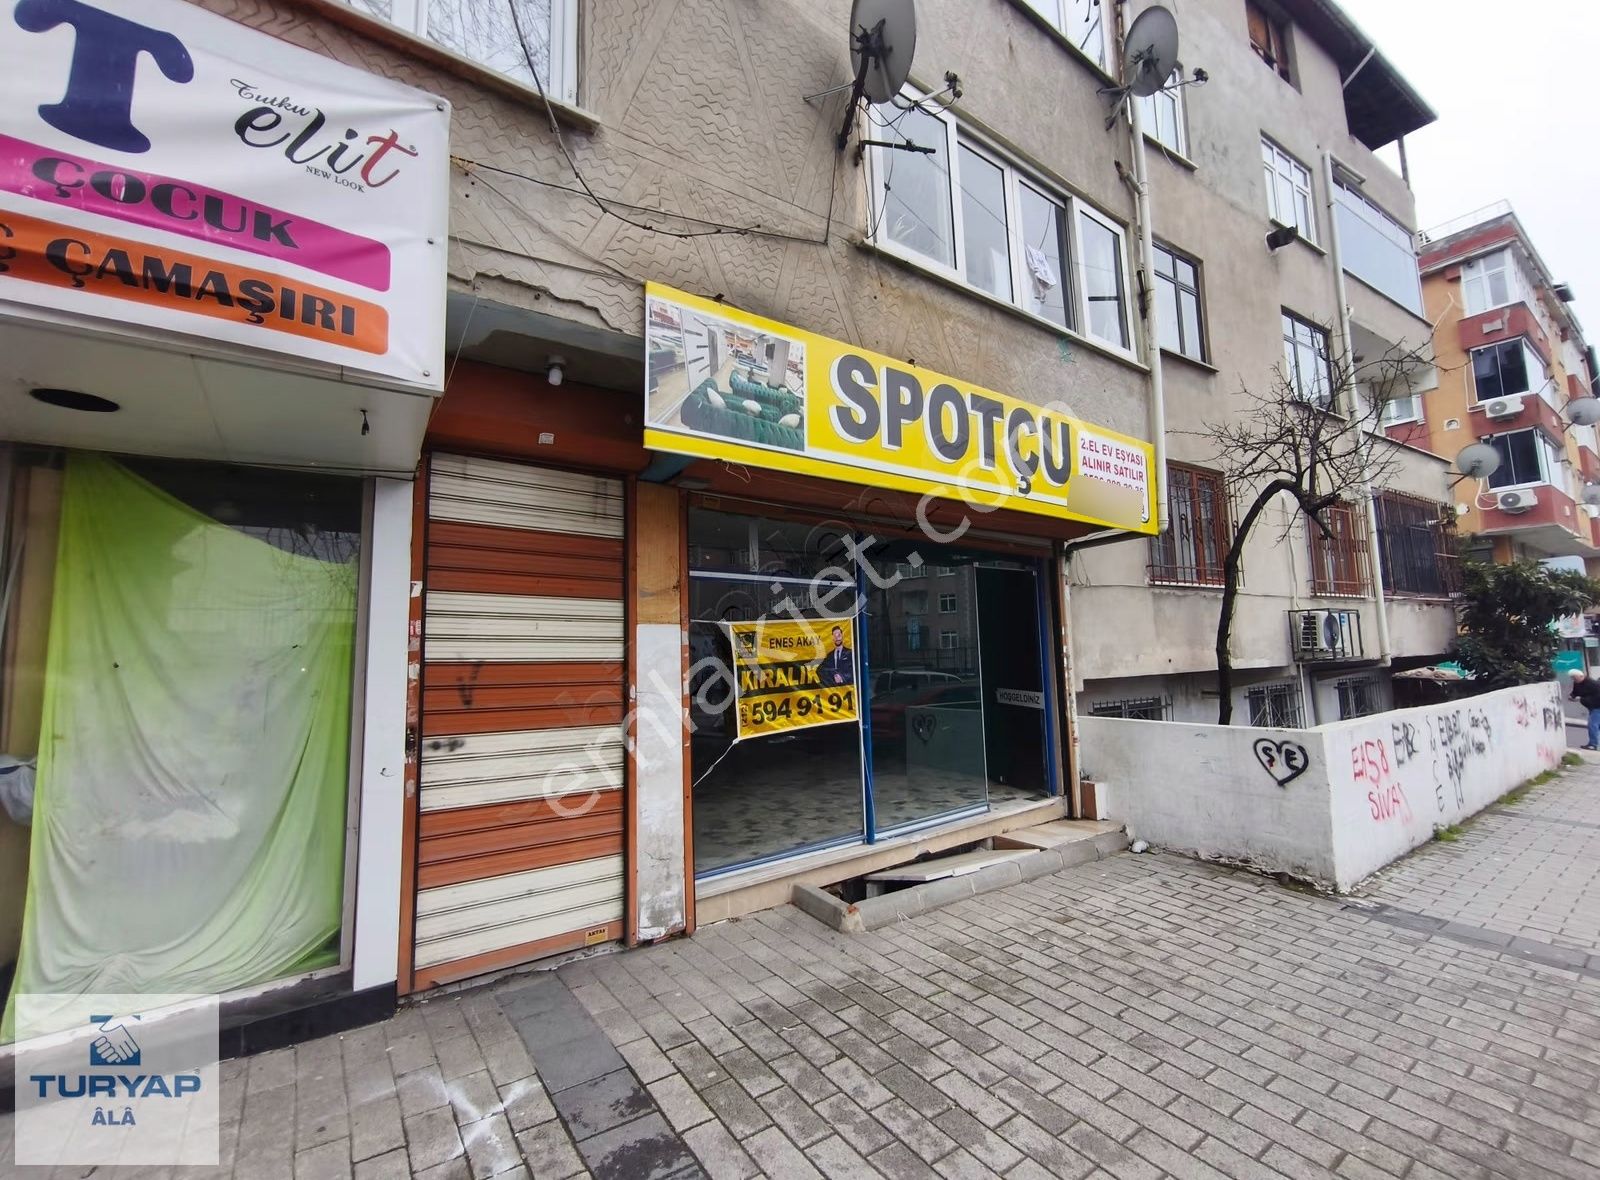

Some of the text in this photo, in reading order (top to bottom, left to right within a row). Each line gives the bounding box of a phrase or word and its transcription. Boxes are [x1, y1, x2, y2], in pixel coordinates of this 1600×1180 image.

[234, 106, 419, 188] elit
[305, 165, 366, 194] NEW LOOK
[32, 157, 300, 250] ÇOCUK
[45, 238, 356, 337] ÇAMAŞIRI
[830, 353, 1072, 495] SPOTÇU
[1080, 438, 1143, 466] 2.EL EV EŞYASI
[1082, 455, 1144, 483] ALINIR SATILIR
[769, 637, 794, 649] ENES
[752, 690, 855, 725] 594 91 91
